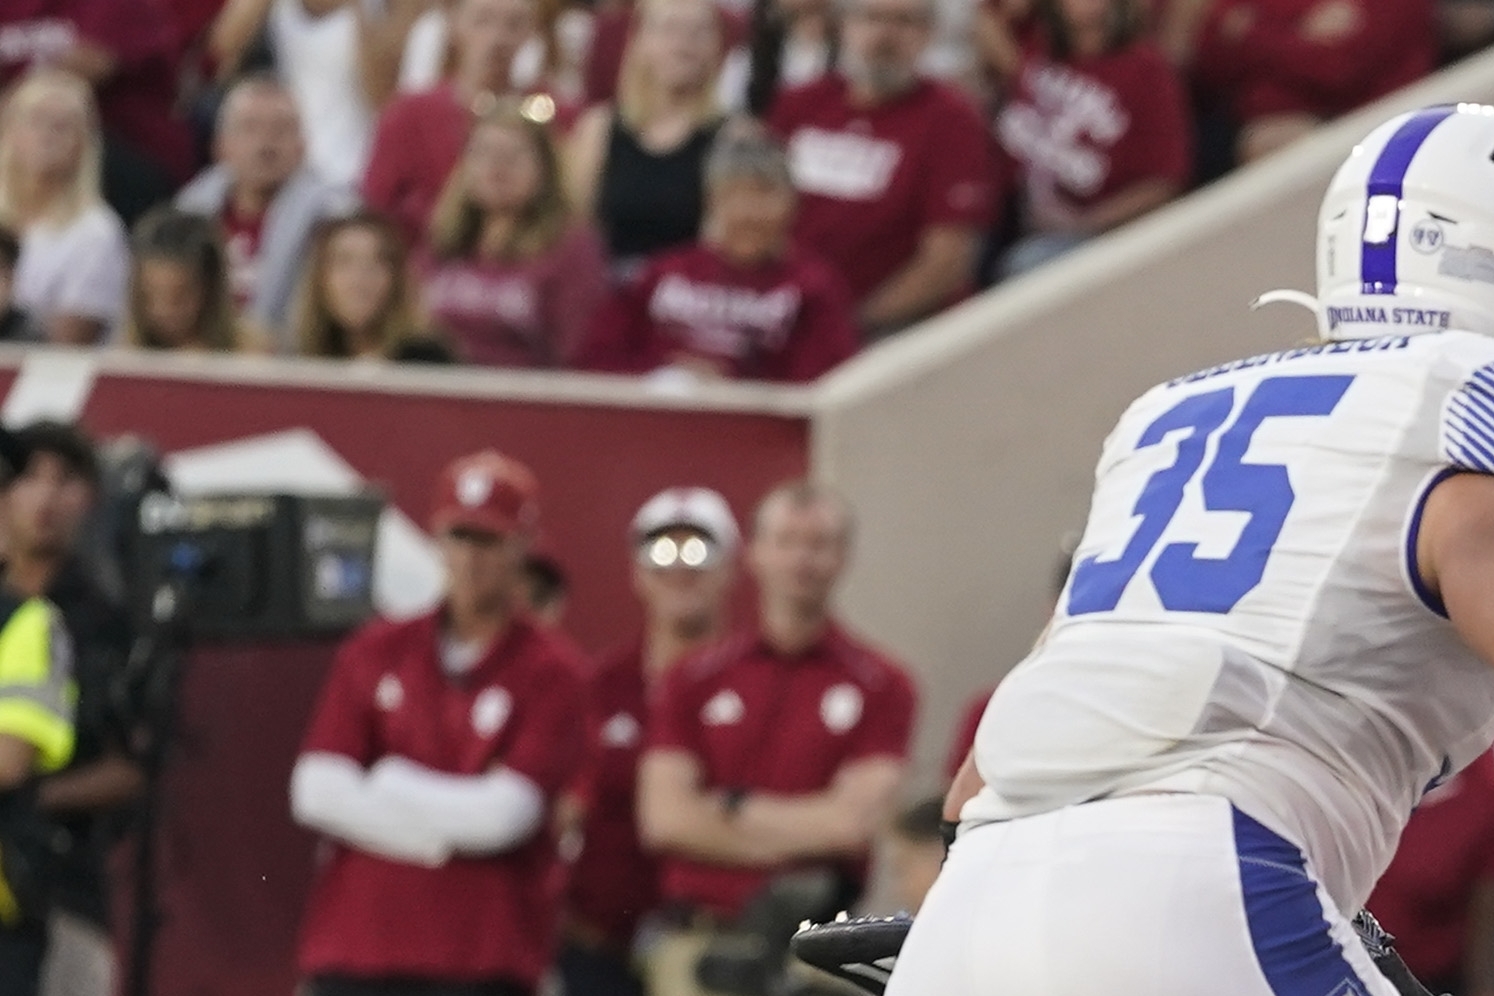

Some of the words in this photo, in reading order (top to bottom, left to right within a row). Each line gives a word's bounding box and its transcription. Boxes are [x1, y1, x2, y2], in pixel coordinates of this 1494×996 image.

[1327, 306, 1387, 331] INDIANA
[1391, 307, 1451, 330] STATE
[1066, 374, 1357, 616] 35
